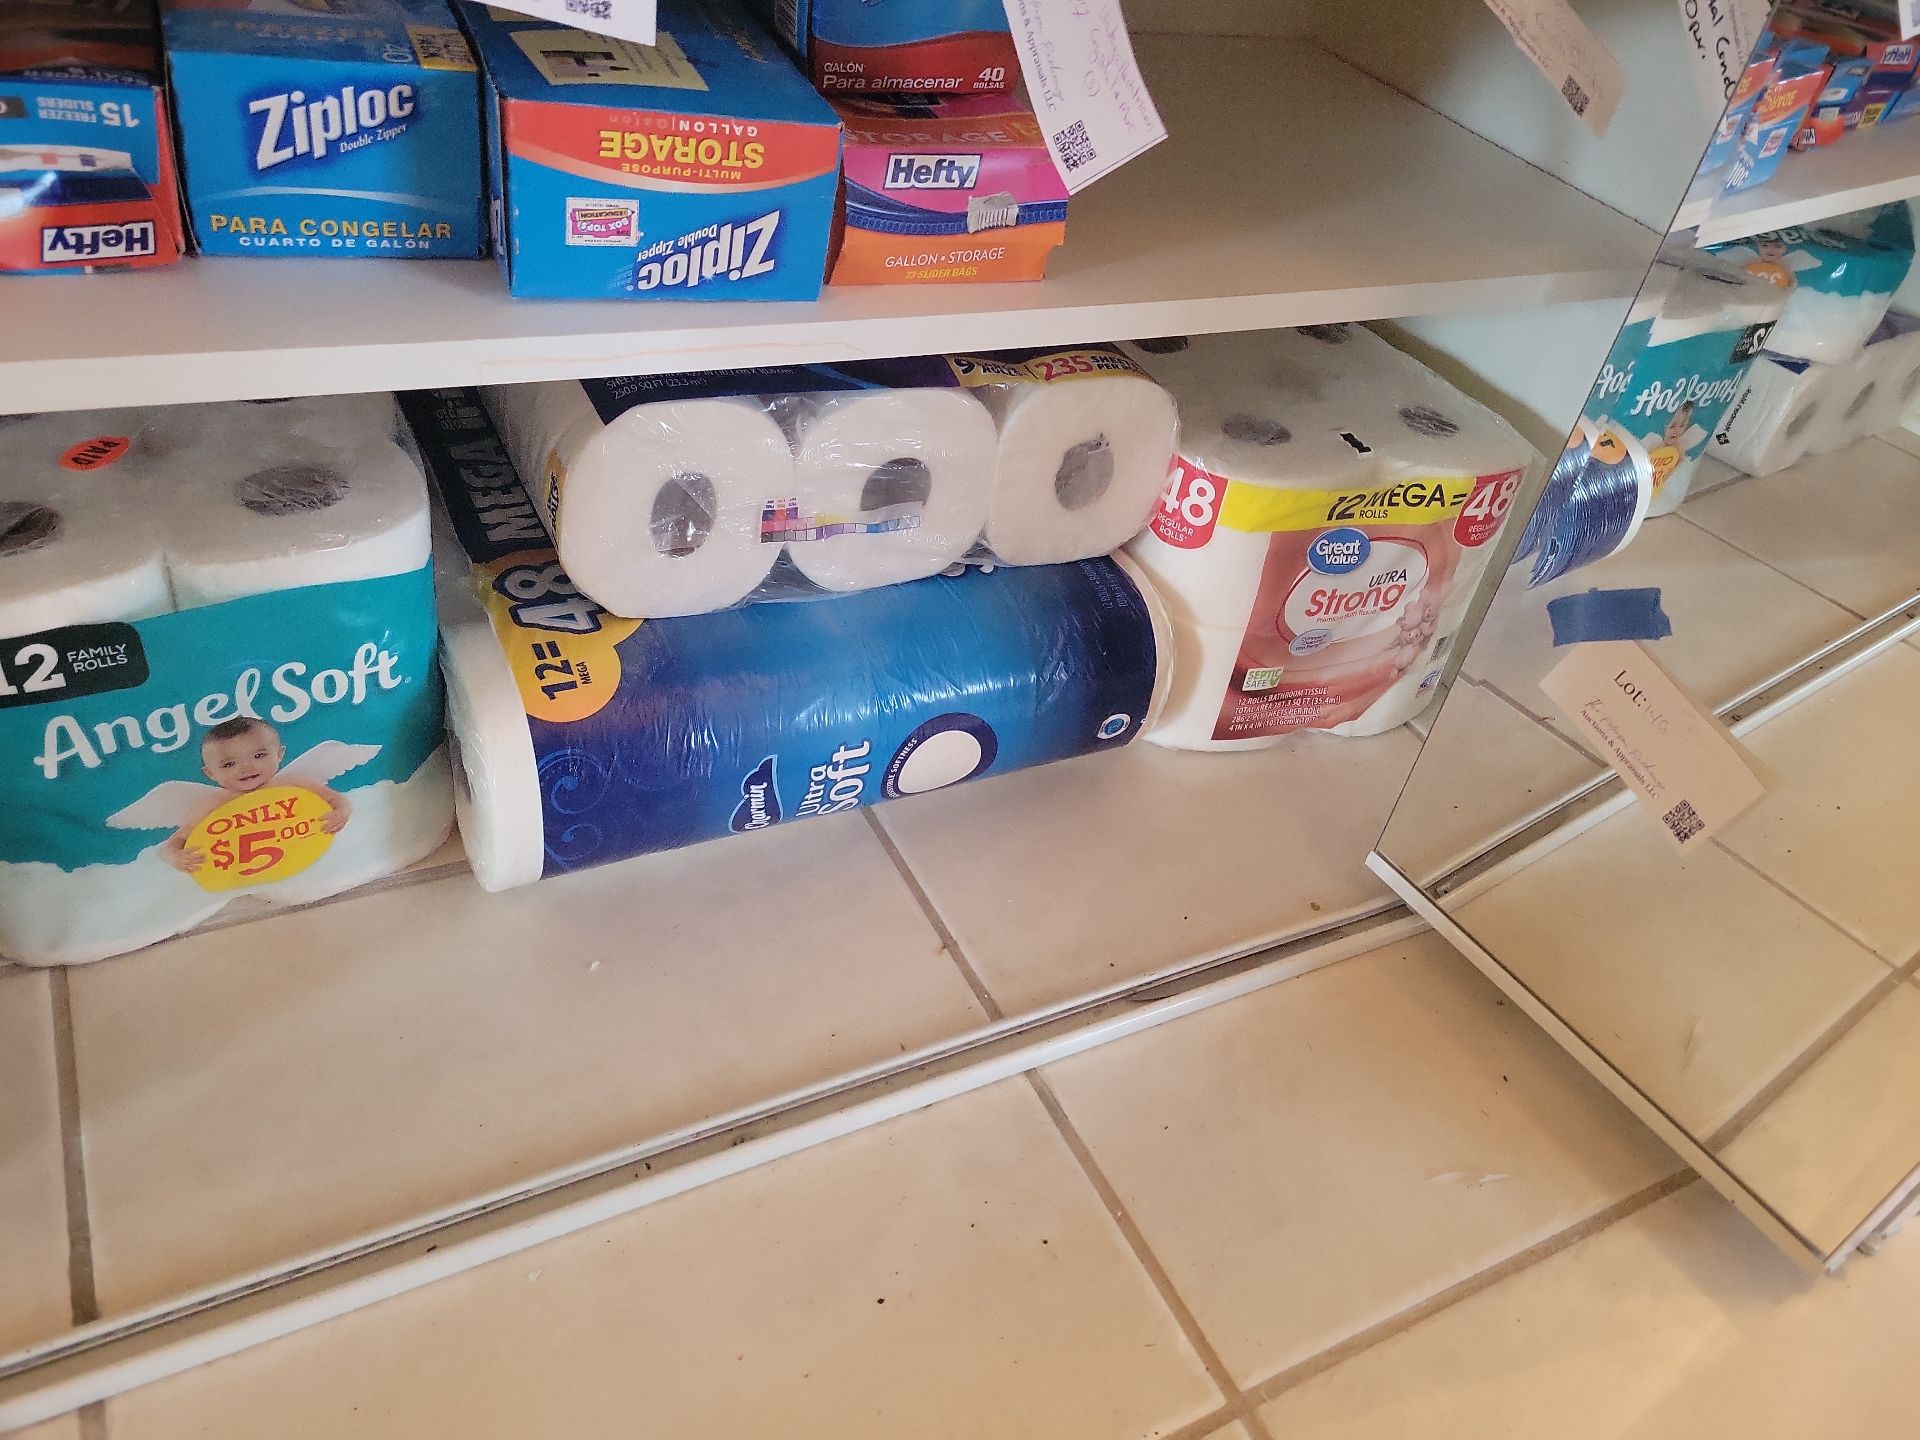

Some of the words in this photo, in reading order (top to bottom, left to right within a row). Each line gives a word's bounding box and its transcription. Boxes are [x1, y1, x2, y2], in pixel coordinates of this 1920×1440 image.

[822, 74, 866, 90] Para
[871, 75, 964, 89] almacenar
[977, 67, 1006, 82] 40
[1025, 31, 1049, 88] Appraisals
[1042, 89, 1057, 113] LLC
[972, 81, 1006, 89] BOLSAS
[36, 96, 95, 111] SLIDERS
[38, 109, 98, 123] FREEZER
[100, 102, 140, 128] 15
[249, 84, 415, 171] Ziploc
[339, 132, 375, 154] Double
[376, 123, 408, 142] Zipper
[678, 119, 758, 137] GALLON
[599, 129, 766, 169] STORAGE
[621, 162, 742, 180] MULTI-PURPOSE
[889, 158, 976, 189] Hefty
[209, 214, 288, 235] PARA
[300, 218, 453, 239] CONGELAR
[580, 210, 624, 219] EDUCATION
[580, 221, 607, 233] TOPS
[608, 217, 630, 231] BOX
[48, 227, 149, 255] Hefty
[239, 236, 322, 248] CUARTO
[331, 238, 356, 248] DE
[678, 223, 718, 249] Double
[636, 239, 675, 263] Zipper
[637, 210, 780, 291] Ziploc
[884, 252, 939, 268] GALLON
[947, 246, 1006, 264] STORAGE
[917, 268, 951, 279] SLIDER
[951, 266, 979, 277] BAGS
[1034, 355, 1094, 381] 235
[612, 383, 638, 400] 250.9
[70, 439, 121, 467] PAID
[450, 442, 546, 544] MEGA
[1162, 466, 1217, 528] 48
[1326, 493, 1368, 521] 12
[1363, 481, 1446, 508] MEGA
[1462, 474, 1519, 522] 48
[1157, 512, 1194, 537] REGULAR
[1359, 508, 1389, 520] ROLLS
[1315, 538, 1362, 557] Great
[1324, 553, 1360, 566] Value
[1368, 568, 1408, 588] ULTRA
[1304, 583, 1408, 618] Strong
[67, 642, 128, 665] FAMILY
[72, 652, 129, 676] ROLLS
[575, 660, 593, 685] MEGA
[1244, 679, 1267, 688] SAFE
[1247, 668, 1282, 680] SEPTIC
[1238, 698, 1247, 706] 12
[1247, 696, 1268, 705] ROLLS
[1268, 691, 1303, 701] BATHROOM
[1305, 686, 1328, 696] TISSUE
[1613, 669, 1648, 708] Lot:
[33, 665, 264, 780] Angel
[271, 641, 403, 727] Soft
[1235, 706, 1254, 715] TOTAL
[1255, 703, 1272, 712] AREA
[1292, 698, 1303, 707] SQ
[1302, 697, 1311, 705] FT
[1265, 708, 1288, 719] SHEETS
[1288, 707, 1303, 716] PER
[890, 737, 919, 773] SOFTNESS
[1579, 709, 1609, 741] Auctions
[1613, 746, 1647, 786] Appraisals
[795, 763, 828, 818] Ultra
[817, 739, 872, 817] Soft
[206, 797, 299, 837] ONLY
[744, 780, 769, 831] Charmin
